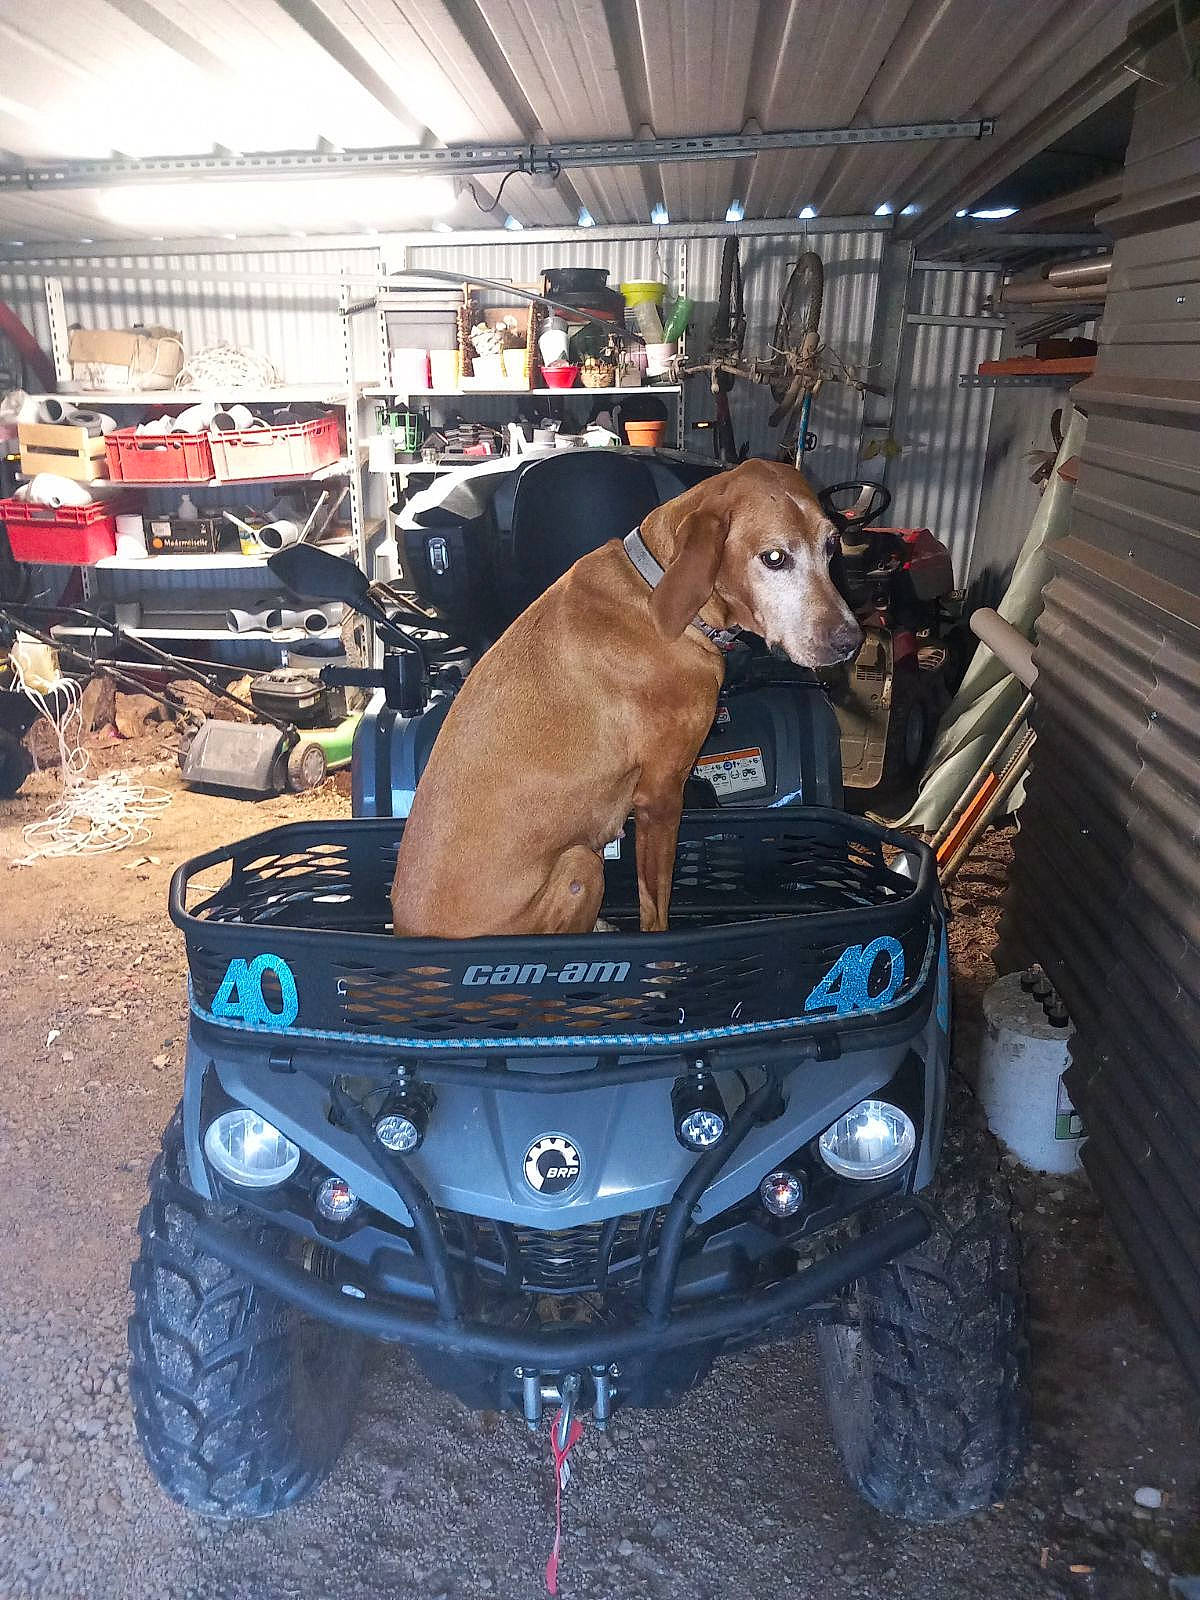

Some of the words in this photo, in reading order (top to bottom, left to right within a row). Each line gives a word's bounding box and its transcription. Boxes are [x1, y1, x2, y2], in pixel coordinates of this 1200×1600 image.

[211, 953, 299, 1027] 40
[461, 961, 631, 986] can-am
[804, 935, 905, 1013] 40
[545, 1167, 579, 1179] BRP
